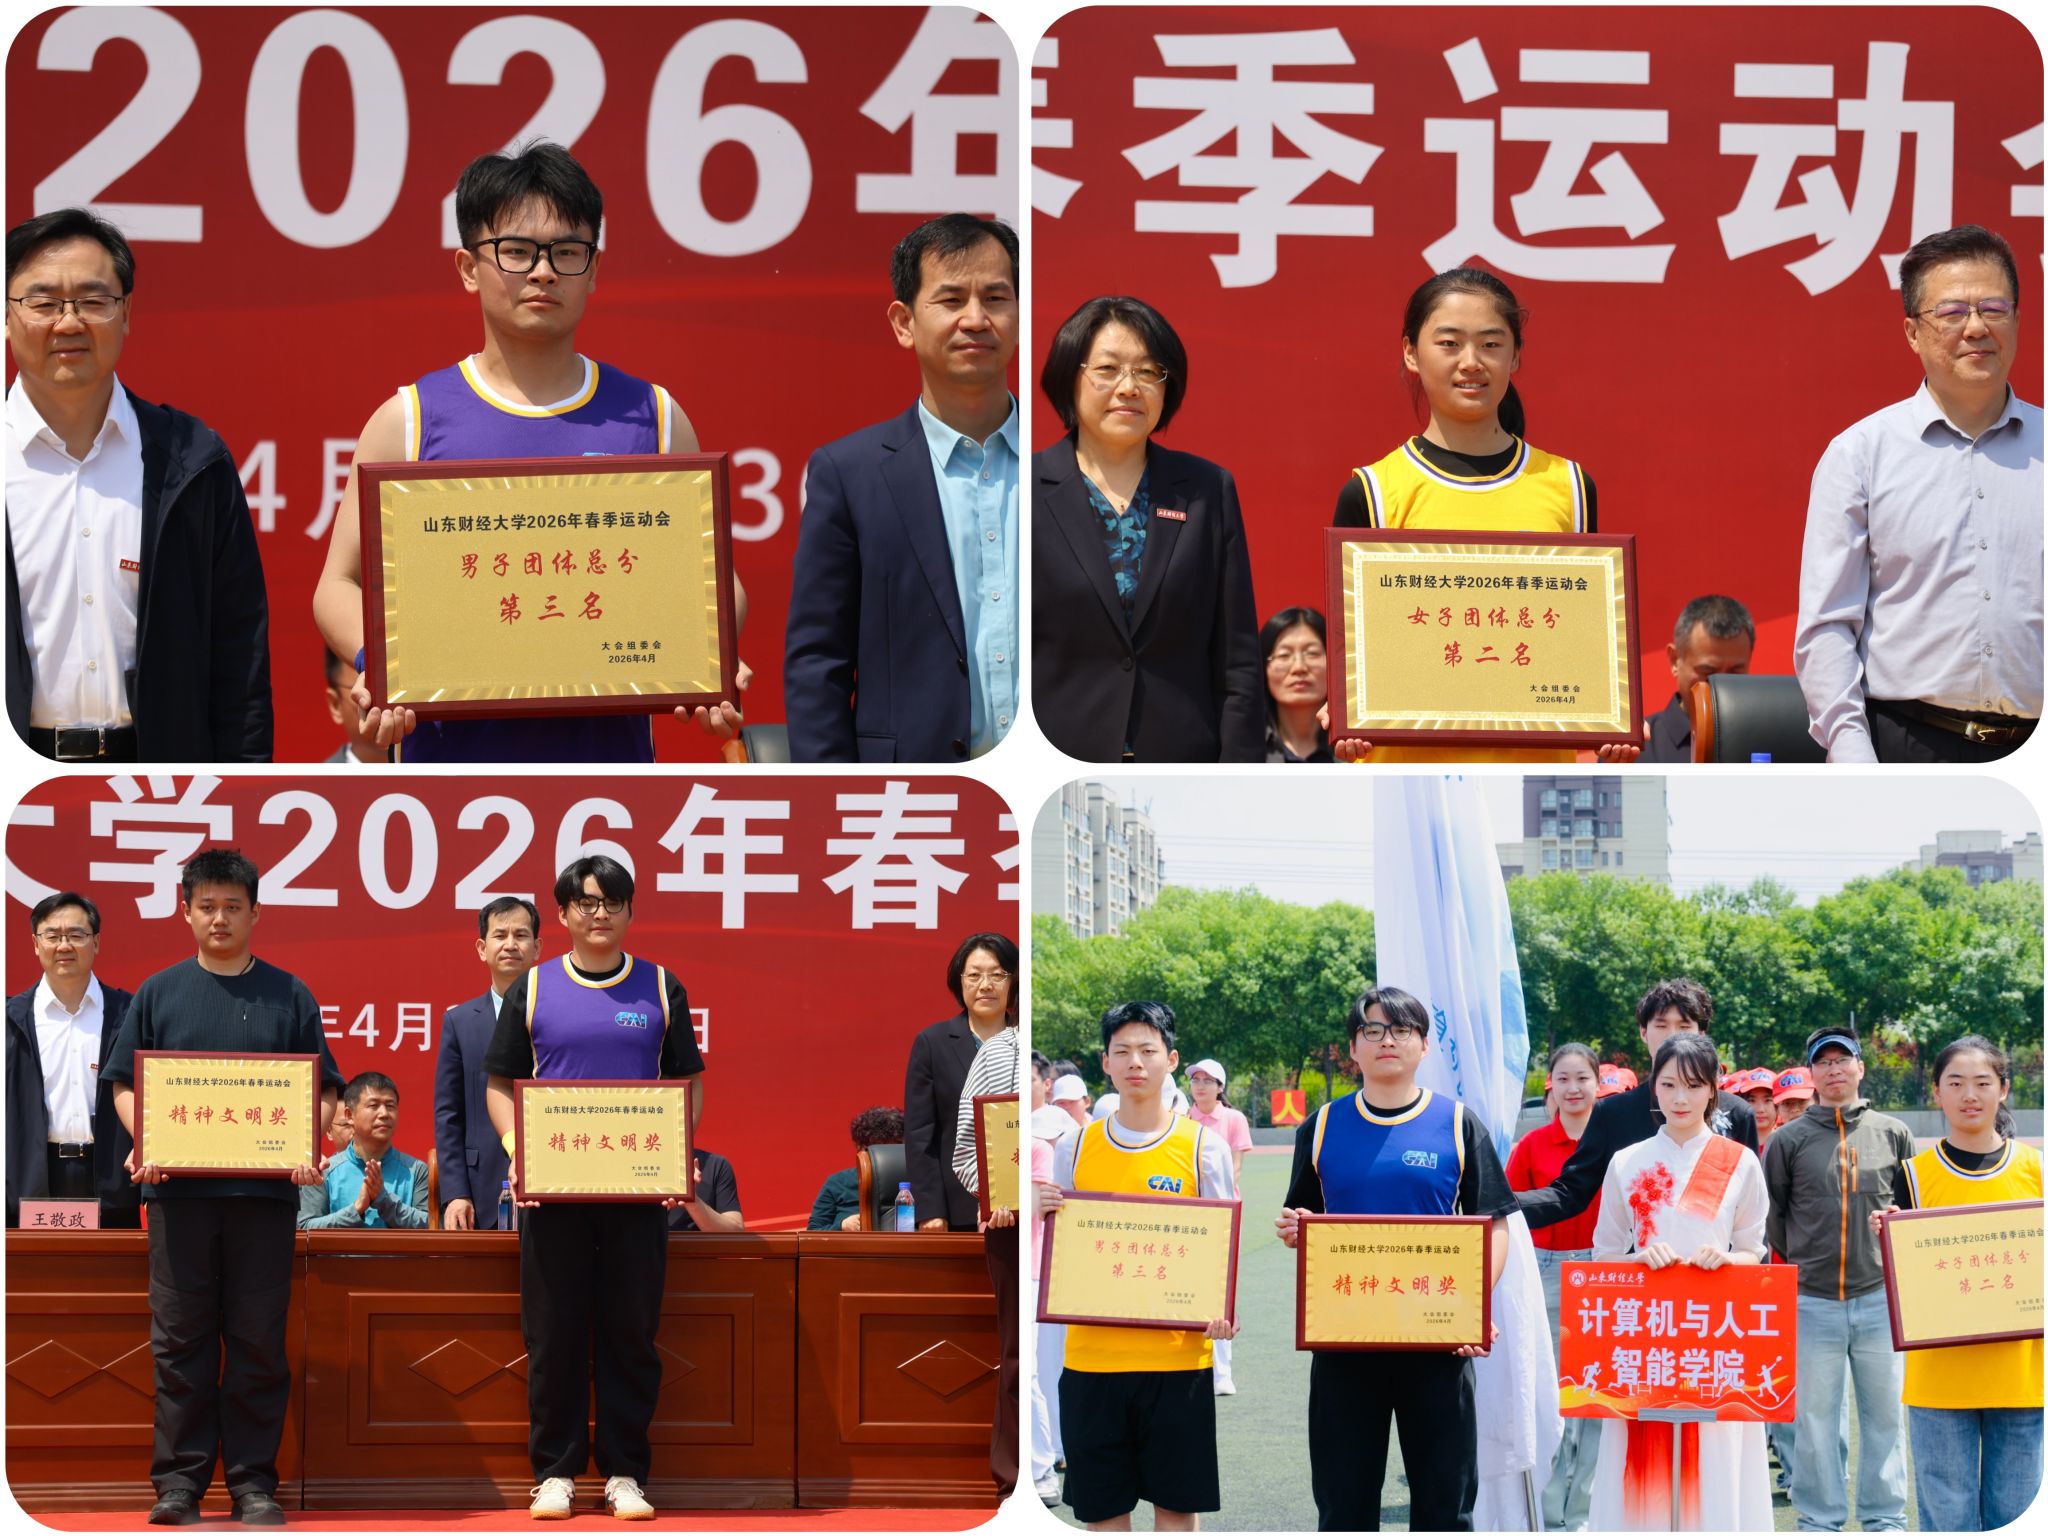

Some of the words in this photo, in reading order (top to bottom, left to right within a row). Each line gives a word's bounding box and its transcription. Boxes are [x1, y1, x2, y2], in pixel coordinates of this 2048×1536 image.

[1031, 28, 2043, 296] 季运动
[423, 510, 671, 533] 山东财经大学2026年春季运动会
[461, 548, 639, 579] 男子团体总分
[1380, 574, 1588, 591] 山东财经大学2026年春季运动会
[499, 591, 604, 625] 第三名
[1407, 607, 1561, 628] 女子团体总分
[601, 640, 662, 651] 大会组委会
[1444, 640, 1532, 667] 第二名
[608, 654, 656, 664] 2026年4月
[1529, 684, 1581, 693] 大会组委会
[1535, 695, 1576, 704] 2026年4月
[5, 775, 1019, 929] 学2026年春
[166, 1077, 291, 1088] 山东财经大学2026年春季运动会
[168, 1104, 288, 1126] 精神文明奖
[544, 1106, 664, 1115] 山东财经大学2026年春季运动会
[548, 1131, 662, 1152] 精神文明奖
[1148, 1175, 1183, 1194] CAI
[32, 1212, 86, 1228] 王敬政
[1077, 1219, 1208, 1236] 山东财经大学2026年春季运动会
[1095, 1240, 1190, 1258] 男子团体总分
[1330, 1244, 1460, 1255] 山东财经大学2026年春季运动会
[1934, 1249, 2030, 1270] 女子团体总分
[1112, 1262, 1168, 1280] 第三名
[1333, 1274, 1457, 1296] 精神文明奖
[1959, 1274, 2015, 1295] 第二名
[1578, 1298, 1780, 1339] 计算机与人工
[1611, 1346, 1745, 1388] 智能学院
